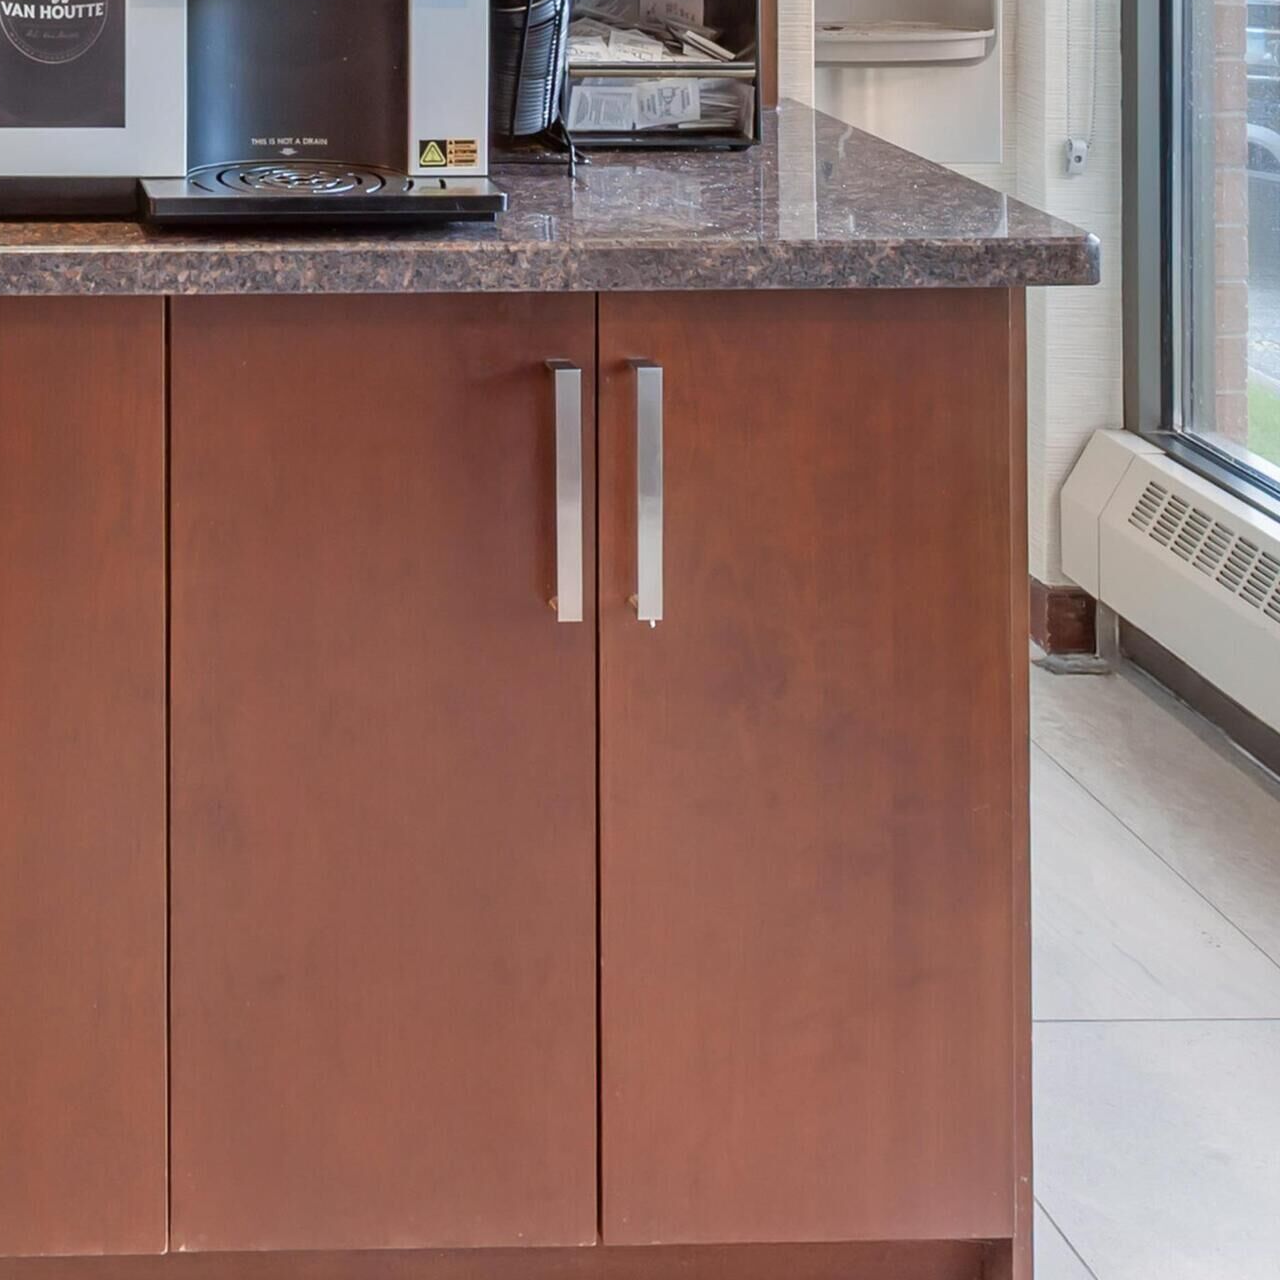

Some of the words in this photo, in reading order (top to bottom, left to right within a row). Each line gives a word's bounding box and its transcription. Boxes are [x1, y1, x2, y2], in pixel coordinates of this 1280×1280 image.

[0, 1, 36, 19] VAN
[40, 2, 104, 20] HOUTTE
[251, 137, 267, 145] THIS
